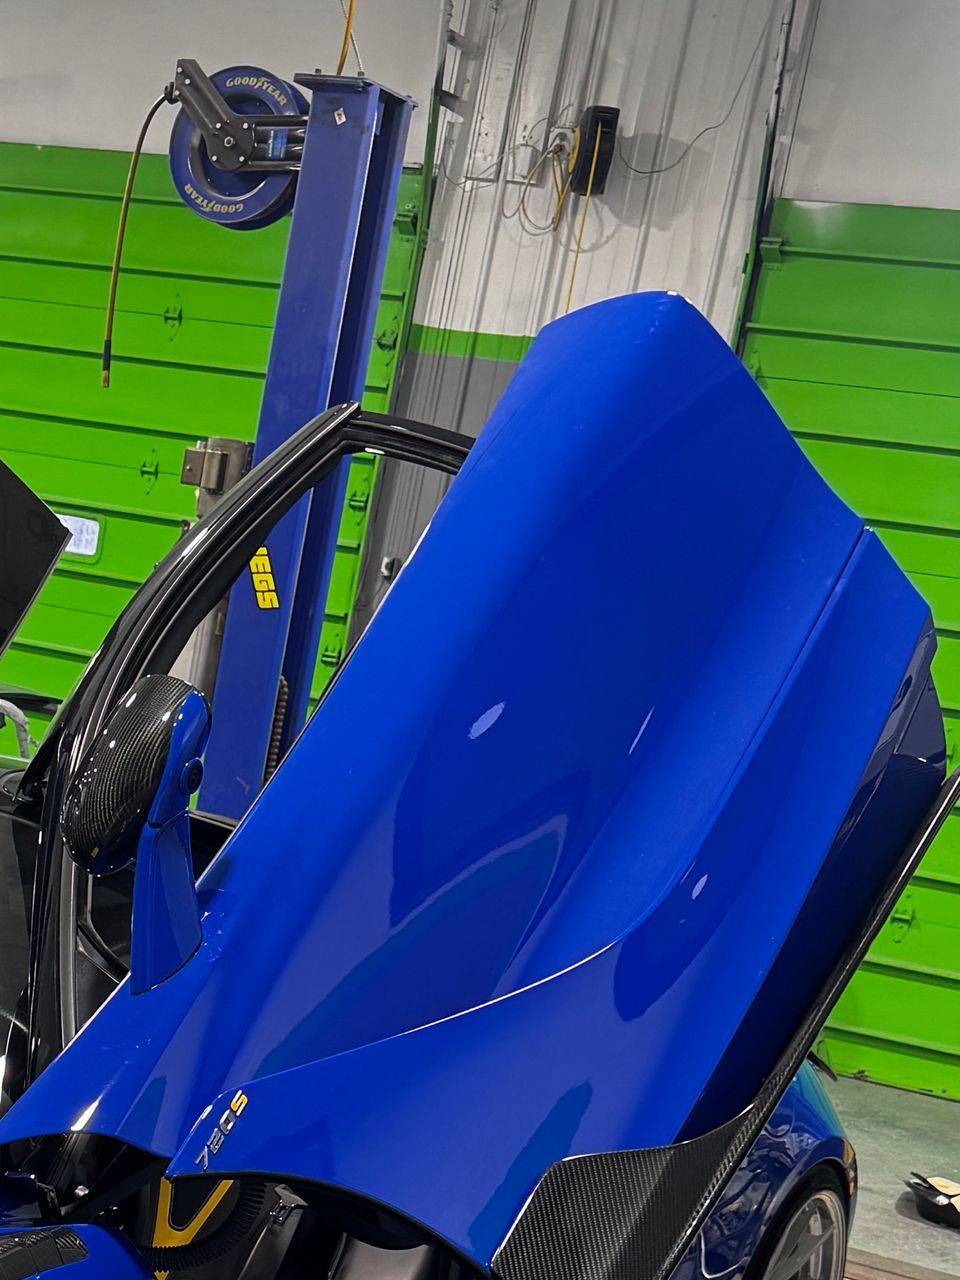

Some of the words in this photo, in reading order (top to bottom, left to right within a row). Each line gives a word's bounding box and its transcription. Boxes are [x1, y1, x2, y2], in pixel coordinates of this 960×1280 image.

[225, 76, 288, 107] GOODYEAR
[184, 183, 244, 213] GOODYEAR
[194, 1089, 248, 1171] 720S
